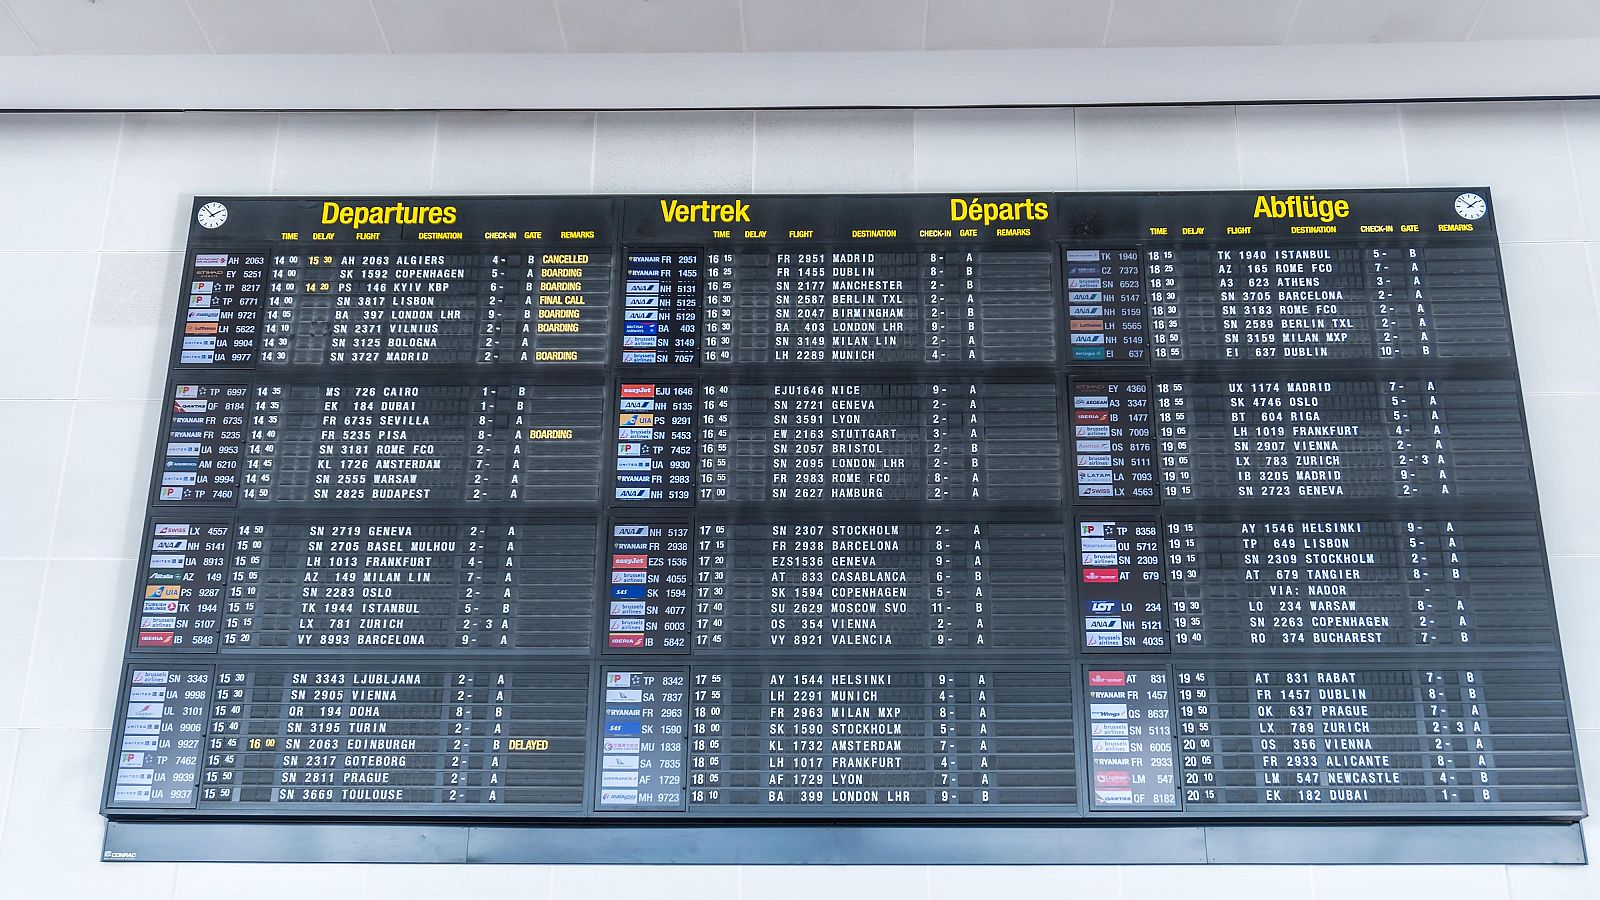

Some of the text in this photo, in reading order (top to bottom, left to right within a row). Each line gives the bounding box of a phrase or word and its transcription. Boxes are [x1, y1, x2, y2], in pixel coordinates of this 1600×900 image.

[661, 200, 750, 222] Vertrek
[951, 199, 1048, 225] Départs
[1254, 196, 1349, 222] Abflüge
[322, 201, 456, 227] Departures
[1150, 227, 1167, 235] TIME
[1183, 227, 1204, 235] DELAY
[1227, 227, 1251, 235] FLIGHT
[1291, 226, 1336, 234] DESTINATION
[1361, 225, 1393, 233] CHECK-IN
[1401, 225, 1418, 233] GATE
[1438, 224, 1473, 232] REMARKS
[282, 233, 298, 241] TIME
[313, 233, 334, 241] DELAY
[356, 232, 379, 240] FLIGHT
[419, 232, 462, 240] DESTINATION
[485, 232, 516, 240] CHECK-IN
[524, 231, 541, 239] GATE
[561, 231, 594, 239] REMARKS
[714, 231, 730, 239] TIME
[745, 231, 766, 239] DELAY
[789, 230, 812, 238] FLIGHT
[852, 230, 896, 238] DESTINATION
[920, 230, 951, 238] CHECK-IN
[960, 229, 977, 237] GATE
[997, 229, 1030, 237] REMARKS
[543, 255, 588, 263] CANCELLED
[1218, 250, 1330, 260] TK 1940 ISTANBUL
[227, 255, 239, 264] AH
[245, 257, 264, 265] 2063
[342, 256, 444, 265] AH 2063 ALGIERS
[662, 256, 696, 264] FR 2951
[340, 269, 464, 278] SK 1592 COPENHAGEN
[542, 269, 582, 277] BOARDING
[777, 268, 874, 276] FR 1455 DUBLIN
[833, 281, 902, 290] MANCHESTER
[1278, 278, 1319, 286] ATHENS
[394, 283, 449, 292] KYIV KBP
[539, 296, 585, 304] FINAL CALL
[1221, 291, 1342, 302] SN 3705 BARCELONA
[776, 309, 904, 319] SN 2047 BIRMINGHAM
[776, 351, 874, 359] LH 2289 MUNICH
[1227, 347, 1327, 357] EI 637 DUBLIN
[326, 387, 418, 396] MS 726 CAIRO
[654, 386, 693, 396] EJU 1646
[775, 386, 859, 395] EJU1646 NICE
[1231, 397, 1318, 407] SK 4746 OSLO
[323, 416, 429, 425] FR 6735 SEVILLA
[774, 415, 860, 424] SN 3591 LYON
[1291, 412, 1320, 421] RIGA
[529, 430, 572, 438] BOARDING
[832, 429, 896, 440] STUTTGART
[1293, 426, 1358, 437] FRANKFURT
[833, 444, 882, 455] BRISTOL
[1294, 441, 1338, 452] VIENNA
[376, 460, 440, 468] AMSTERDAM
[374, 475, 417, 483] WARSAW
[372, 489, 430, 498] BUDAPEST
[832, 488, 882, 497] HAMBURG
[310, 526, 411, 536] SN 2719 GENEVA
[773, 526, 898, 535] SN 2307 STOCKHOLM
[1302, 523, 1360, 532] HELSINKI
[367, 542, 455, 551] BASEL MULHOU
[1304, 539, 1349, 548] LISBON
[773, 557, 875, 566] EZS1536 GENEVA
[832, 572, 906, 583] CASABLANCA
[1307, 570, 1360, 579] TANGIER
[646, 588, 685, 597] SK 1594
[832, 588, 906, 597] COPENHAGEN
[1270, 585, 1346, 595] VIA: NADOR
[302, 603, 419, 613] TK 1944 ISTANBUL
[831, 603, 906, 612] MOSCOW SVO
[358, 635, 424, 644] BARCELONA
[771, 635, 891, 644] VY 8921 VALENCIA
[1251, 633, 1381, 643] RO 374 BUCHAREST
[292, 673, 420, 684] SN 3343 LJUBLJANA
[771, 675, 891, 684] AY 1544 HELSINKI
[1256, 673, 1355, 683] AT 831 RABAT
[163, 705, 202, 715] UL 3101
[832, 707, 900, 717] MILAN MXP
[1320, 706, 1368, 716] PRAGUE
[832, 724, 901, 734] STOCKHOLM
[1322, 722, 1369, 732] ZURICH
[347, 739, 415, 749] EDINBURGH
[509, 739, 548, 750] DELAYED
[830, 740, 901, 751] AMSTERDAM
[345, 755, 405, 766] GOTEBORG
[1131, 758, 1172, 767] FR 2933
[1263, 756, 1389, 766] FR 2933 ALICANTE
[638, 775, 680, 784] AF 1729
[1327, 773, 1400, 784] NEWCASTLE
[342, 788, 402, 799] TOULOUSE
[833, 790, 909, 801] LONDON LHR
